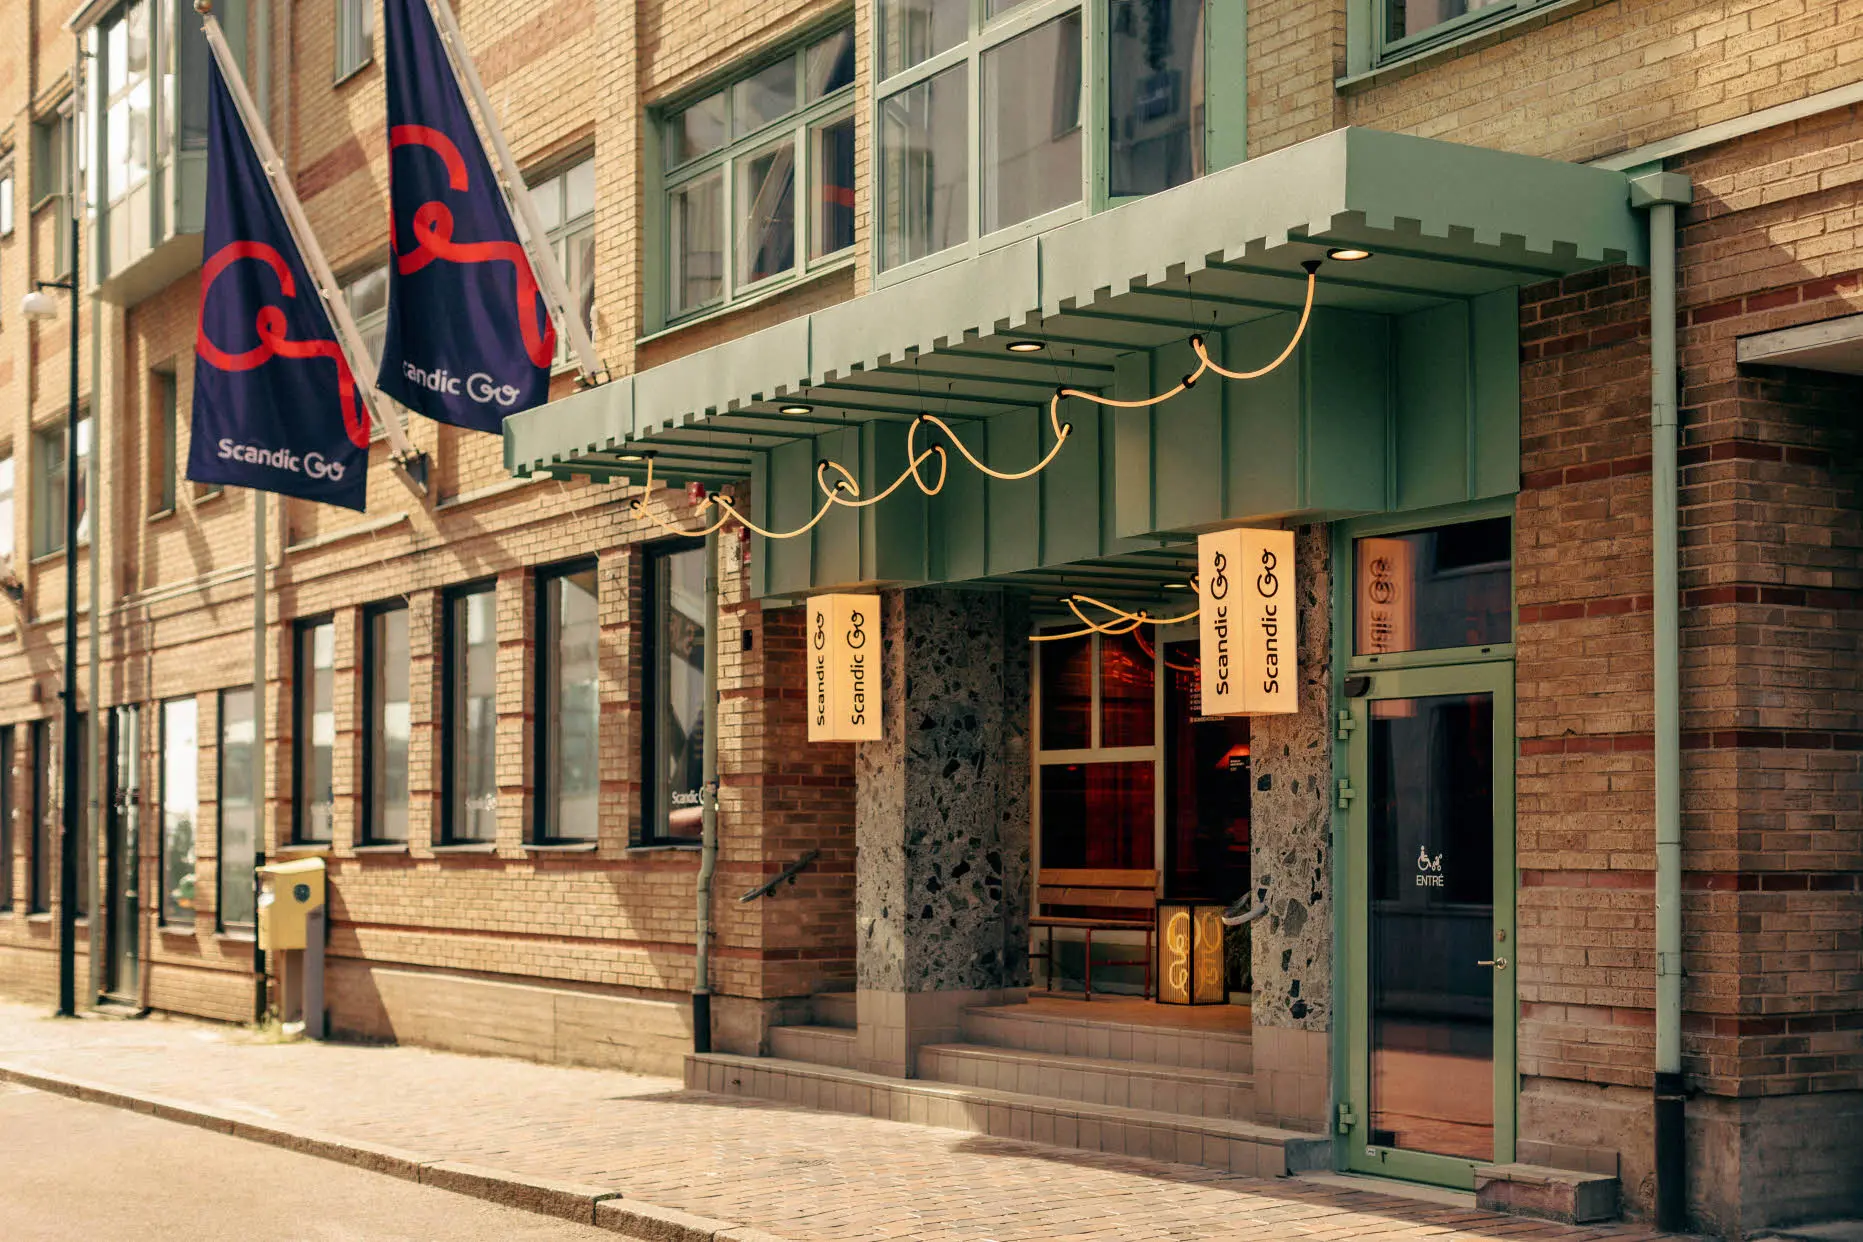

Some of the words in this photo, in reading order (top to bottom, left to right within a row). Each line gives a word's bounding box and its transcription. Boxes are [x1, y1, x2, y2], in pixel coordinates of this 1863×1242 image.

[466, 372, 521, 406] Go
[217, 437, 301, 473] Scandic
[304, 451, 346, 481] Go
[1210, 551, 1229, 600] Go
[1257, 548, 1279, 598] Go
[814, 611, 825, 650] Go
[847, 609, 865, 649] Go
[1214, 605, 1229, 696] Scandic
[1261, 604, 1279, 694] Scandic
[815, 654, 825, 726] Scandic
[850, 654, 864, 725] Scandic
[672, 790, 698, 804] Scandic
[1416, 873, 1444, 887] ENTRÉ
